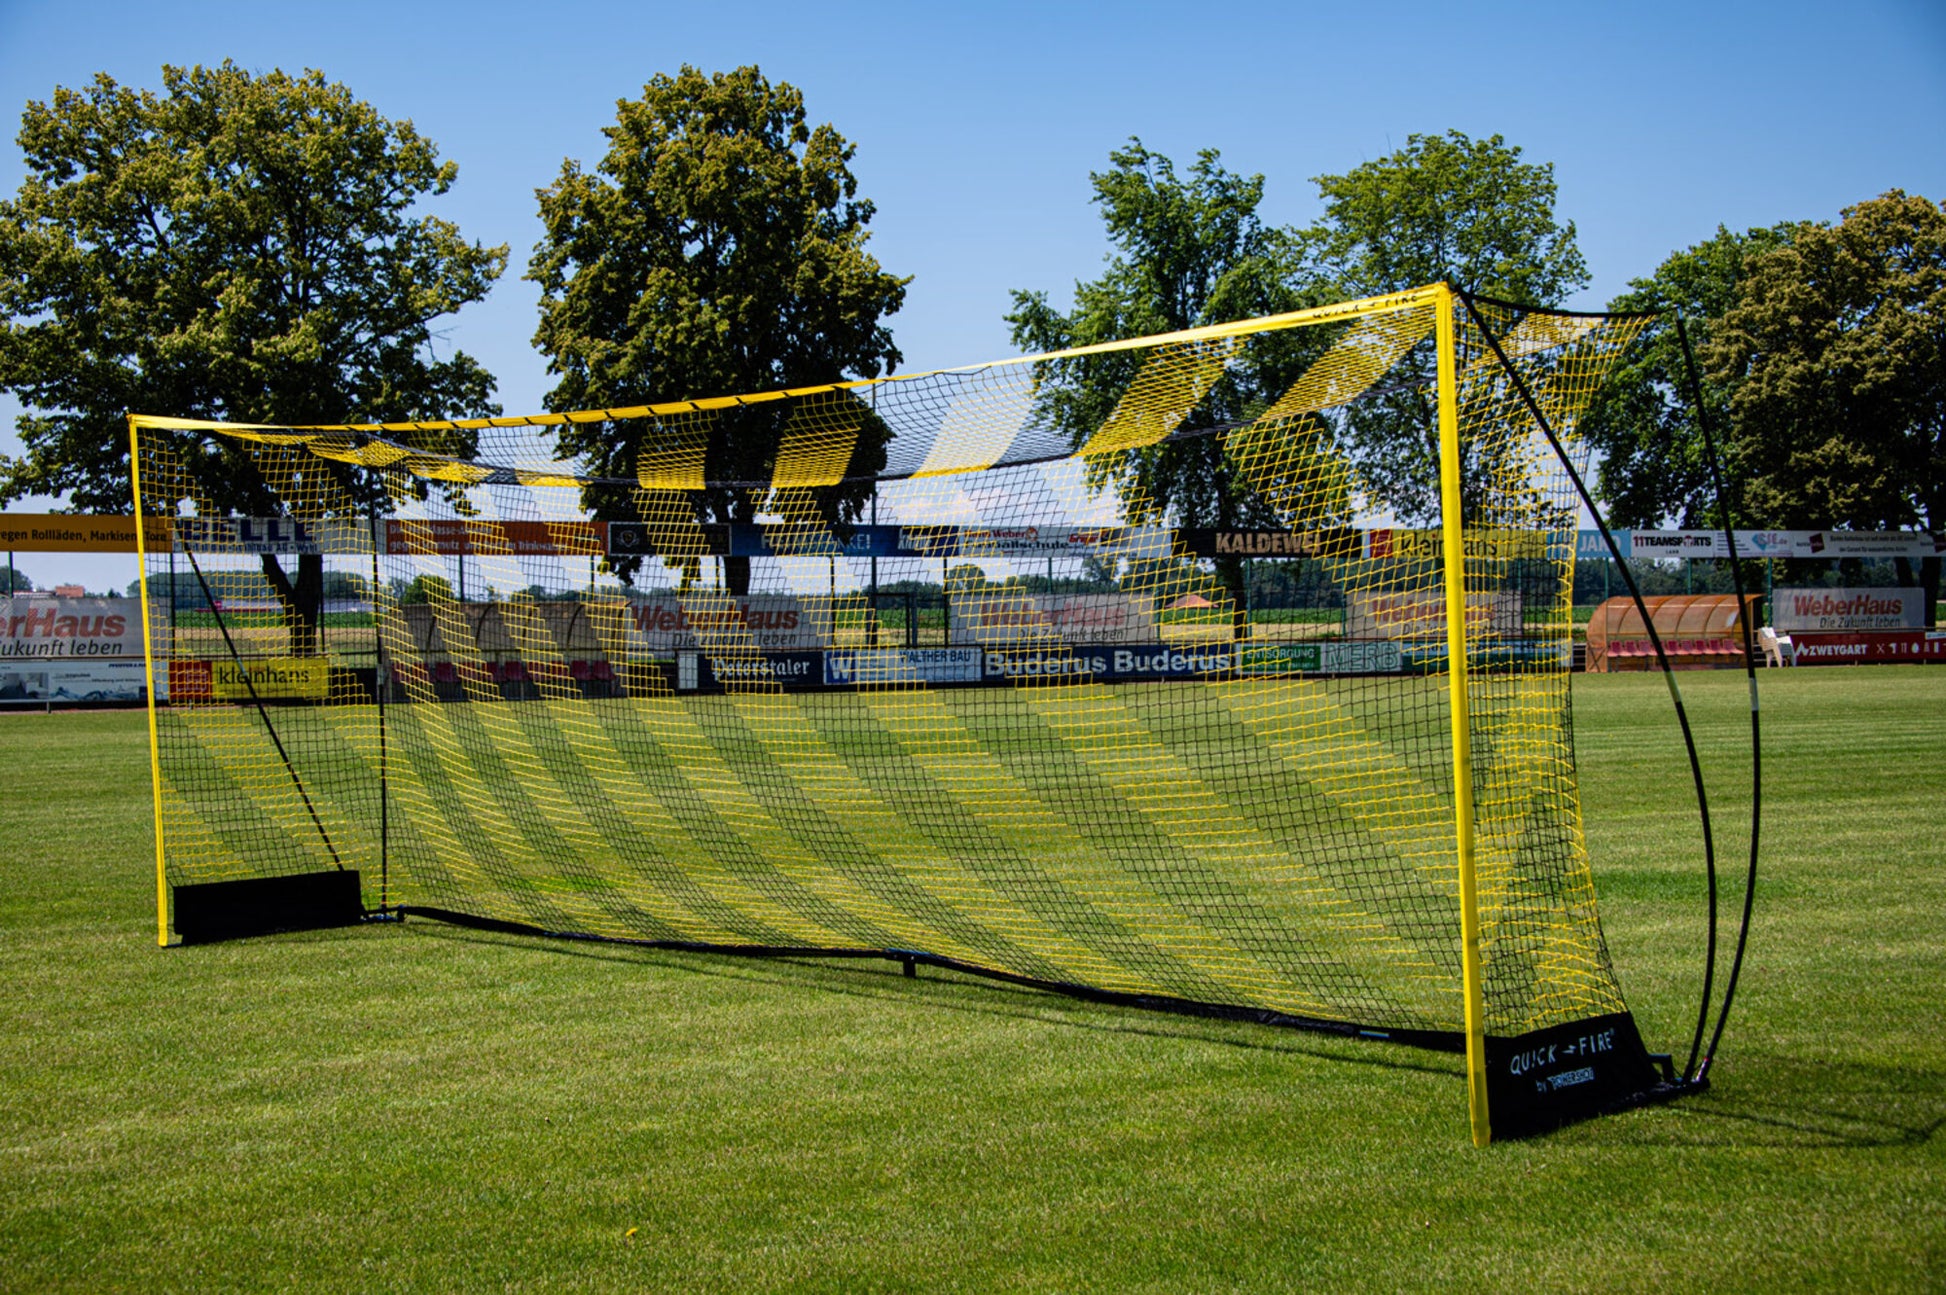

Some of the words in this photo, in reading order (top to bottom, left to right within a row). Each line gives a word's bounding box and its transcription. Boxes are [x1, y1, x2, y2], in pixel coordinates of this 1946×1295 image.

[0, 531, 28, 543] egen
[1215, 532, 1320, 554] KALDEWEI
[1793, 594, 1903, 617] WeberHaus
[1819, 617, 1836, 628] Die
[0, 639, 65, 656] ukunft
[70, 639, 122, 655] leben
[1808, 643, 1868, 656] ZWEYGART
[899, 650, 947, 663] WALTHER
[949, 650, 972, 662] BAU
[984, 652, 1107, 676] Buderus
[1113, 649, 1231, 672] Buderus
